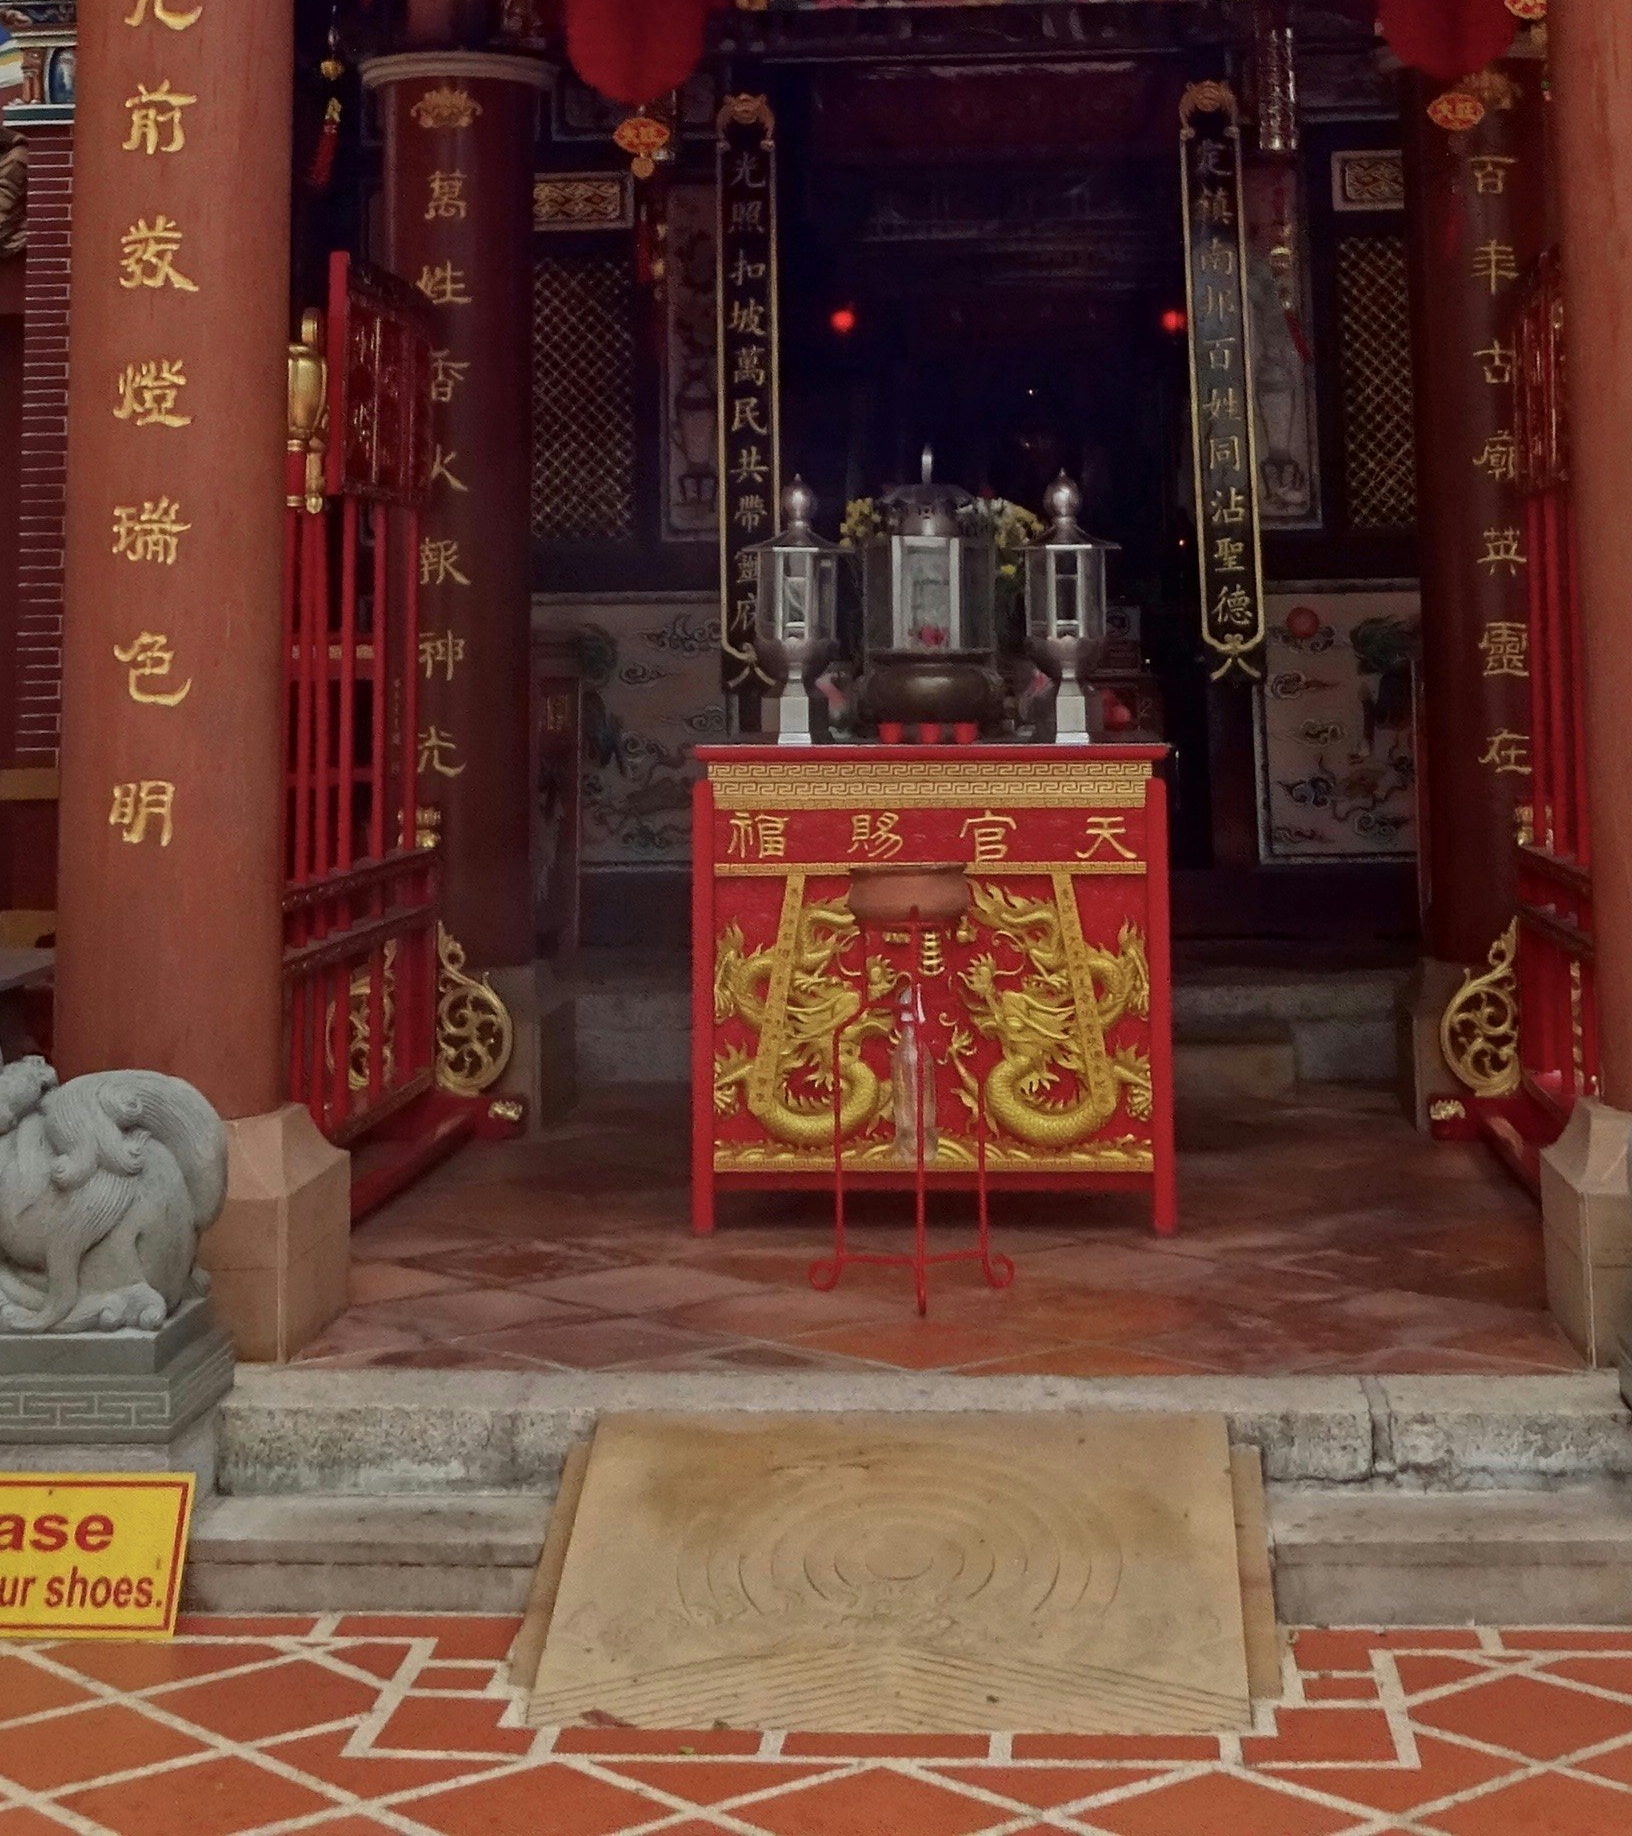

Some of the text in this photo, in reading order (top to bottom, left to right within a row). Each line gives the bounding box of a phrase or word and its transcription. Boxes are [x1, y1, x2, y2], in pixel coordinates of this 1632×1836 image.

[726, 810, 1137, 863] 天官賜福
[44, 1563, 163, 1611] shoes.
